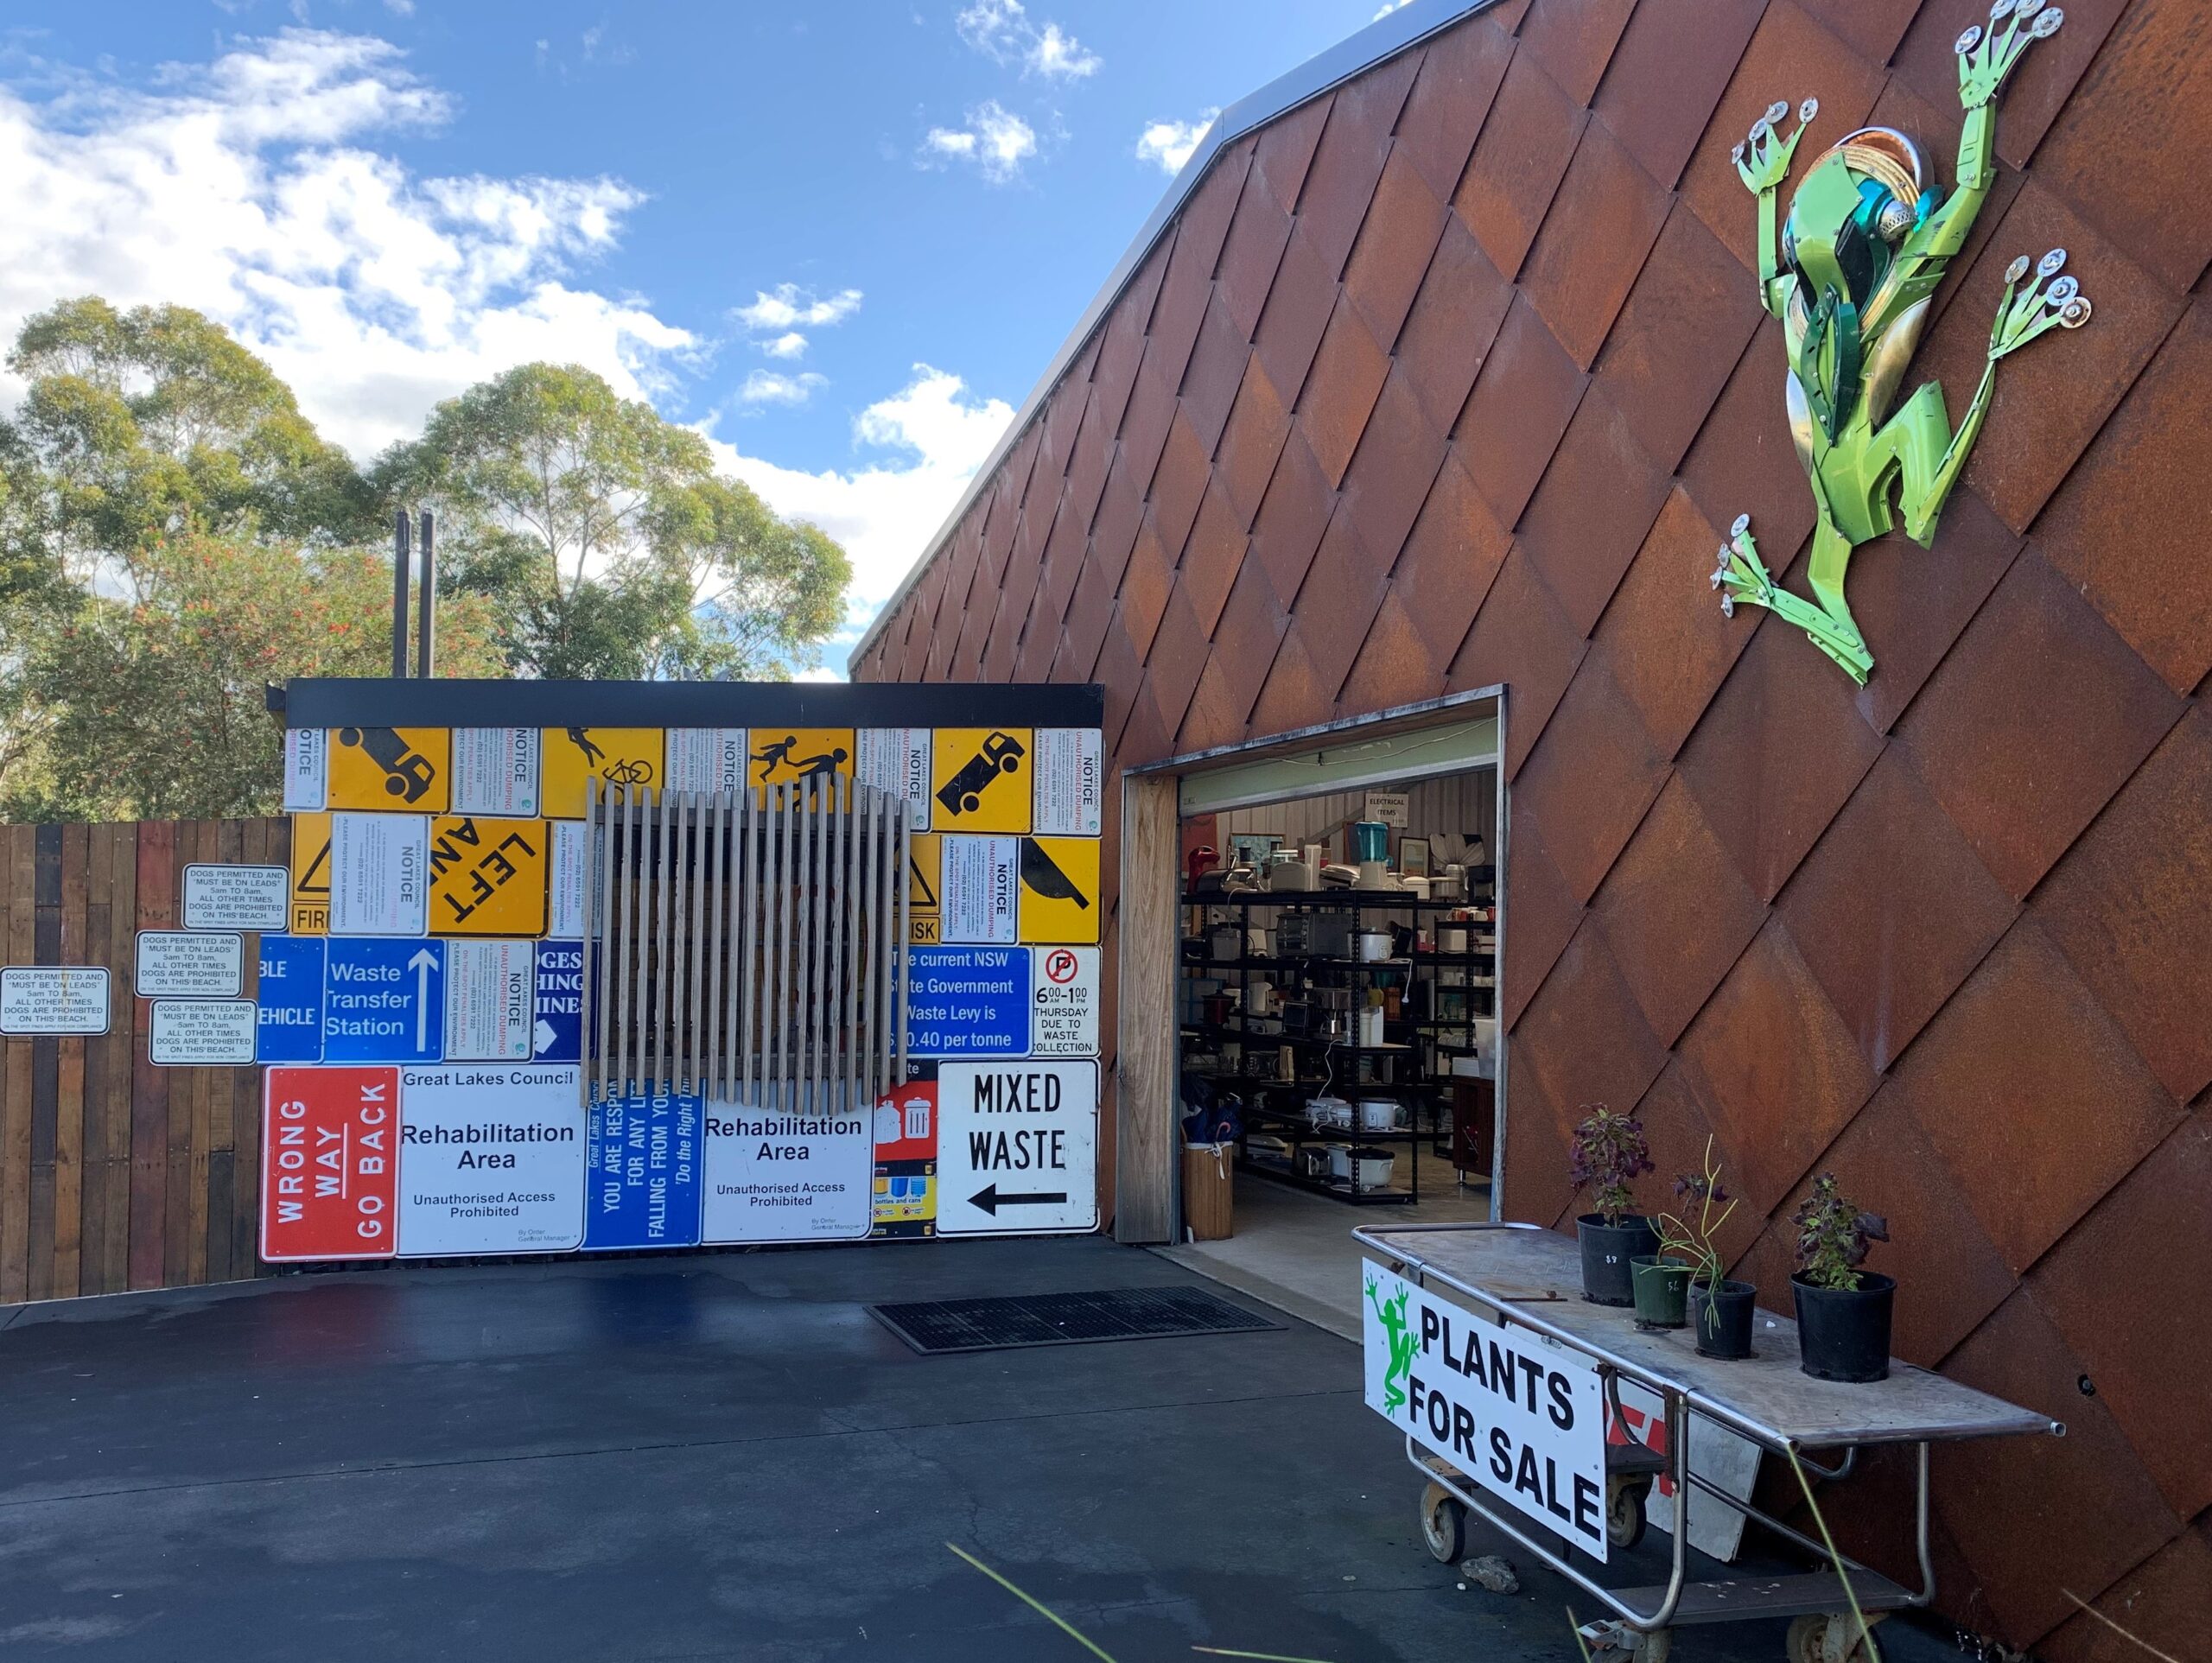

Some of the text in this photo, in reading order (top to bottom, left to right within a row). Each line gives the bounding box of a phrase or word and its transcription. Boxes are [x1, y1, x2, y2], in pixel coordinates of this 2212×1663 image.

[300, 730, 311, 775] OTICE
[515, 729, 526, 782] NOTICE
[724, 741, 734, 791] NOTICE
[910, 750, 920, 799] NOTICE
[1084, 758, 1093, 805] NOTICE
[401, 847, 413, 902] NOTICE
[443, 832, 536, 924] LEFT
[997, 864, 1007, 914] NOTICE
[297, 910, 329, 928] FIR
[912, 922, 935, 939] ISK
[259, 961, 287, 977] BLE
[331, 962, 401, 981] Waste
[537, 952, 582, 968] GES
[893, 952, 1008, 967] Te current NSW
[499, 945, 508, 1012] UNAUTHORISED
[537, 974, 582, 990] HING
[928, 978, 1014, 993] Government
[509, 973, 521, 1026] NOTICE
[258, 1007, 315, 1025] EHICLE
[327, 1017, 404, 1036] Station
[907, 1006, 995, 1023] Waste Levy is
[944, 1034, 967, 1050] per
[970, 1032, 1012, 1046] tonne
[404, 1071, 573, 1086] Great Lakes Council
[975, 1074, 1060, 1113] MIXED
[589, 1115, 600, 1140] Lakes
[677, 1102, 695, 1137] Right
[706, 1117, 861, 1136] Rehabilitation
[402, 1123, 574, 1144] Rehabilitation
[629, 1117, 645, 1149] ANY
[589, 1145, 599, 1168] Great
[604, 1080, 623, 1213] YOU ARE RESPON
[651, 1127, 668, 1169] FROM
[677, 1140, 691, 1160] the
[756, 1142, 809, 1160] Area
[969, 1130, 1065, 1171] WASTE
[278, 1101, 305, 1223] WRONG
[315, 1127, 340, 1197] WAY
[357, 1083, 385, 1238] GO BACK
[457, 1150, 516, 1169] Area
[627, 1158, 644, 1186] FOR
[414, 1192, 556, 1205] Unauthorised Access
[717, 1183, 845, 1195] Unauthorised Access
[750, 1196, 812, 1207] Prohibited
[451, 1206, 518, 1217] Prohibited
[648, 1177, 666, 1238] FALLING
[1421, 1304, 1574, 1431] PLANTS
[1409, 1374, 1601, 1543] FOR SALE
